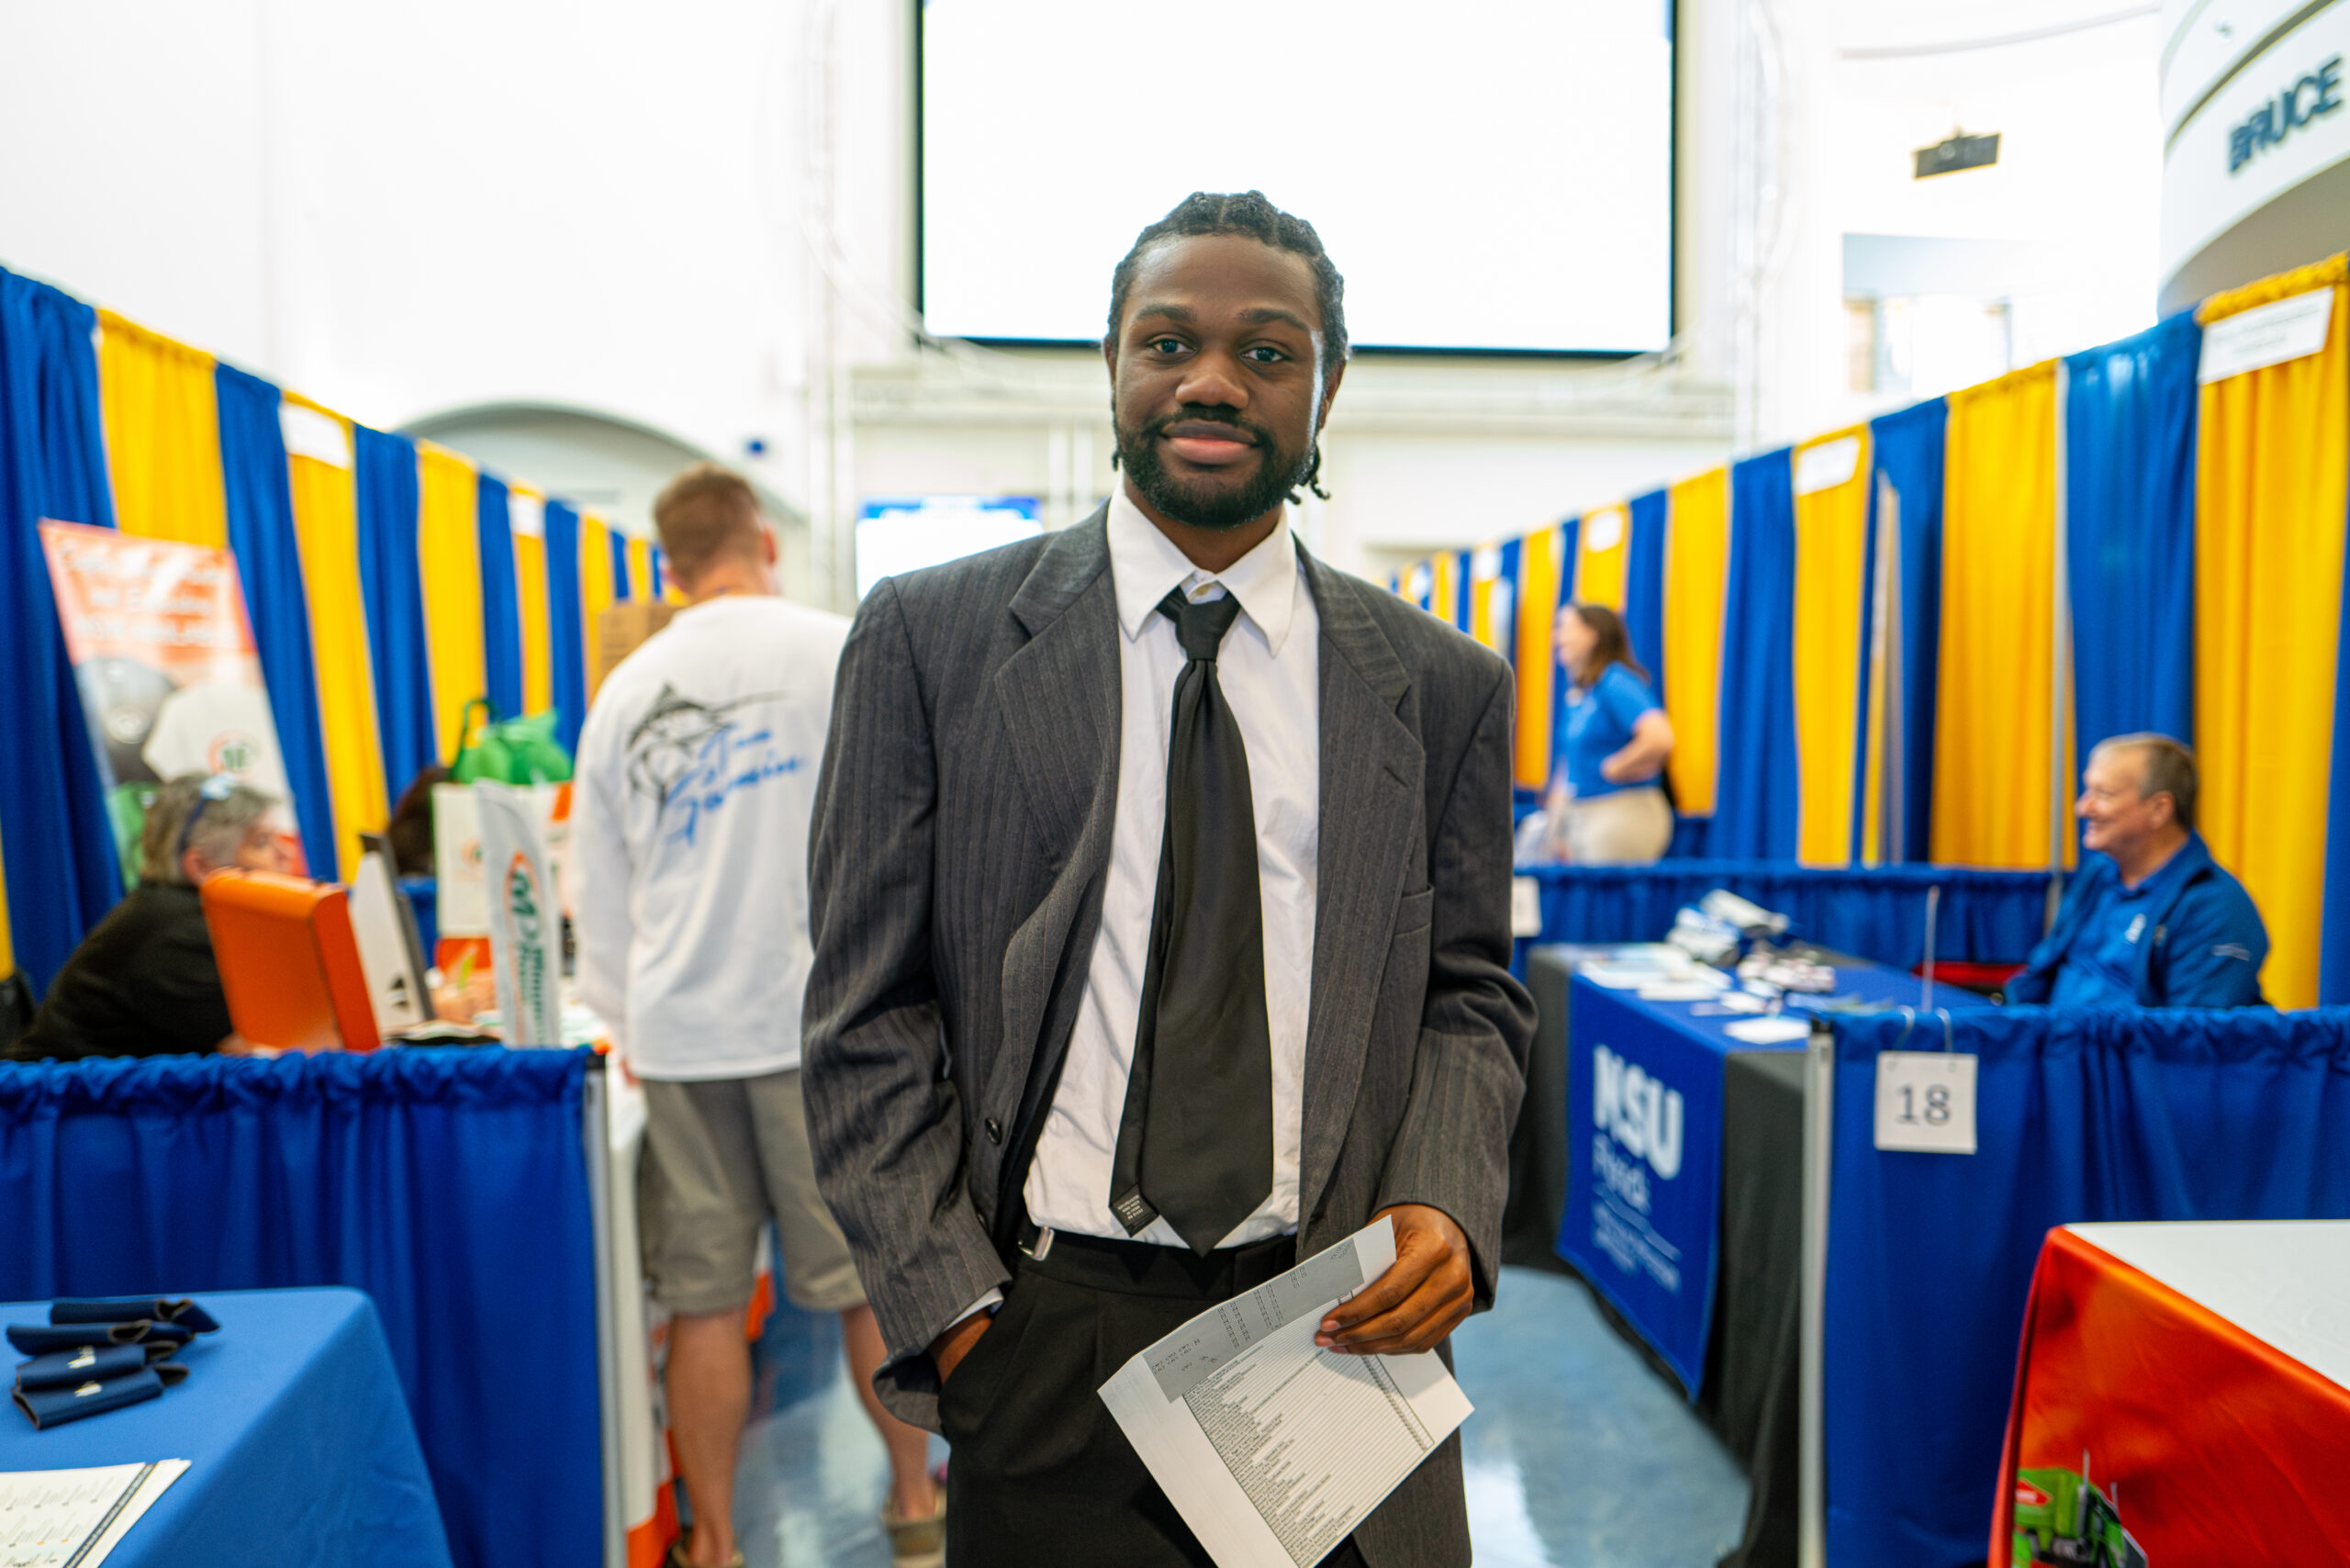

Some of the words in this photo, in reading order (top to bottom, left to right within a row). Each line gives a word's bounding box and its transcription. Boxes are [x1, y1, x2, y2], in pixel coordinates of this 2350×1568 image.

[2229, 57, 2343, 172] BRUCE
[1593, 1044, 1684, 1181] NSU
[1896, 1083, 1952, 1126] 18
